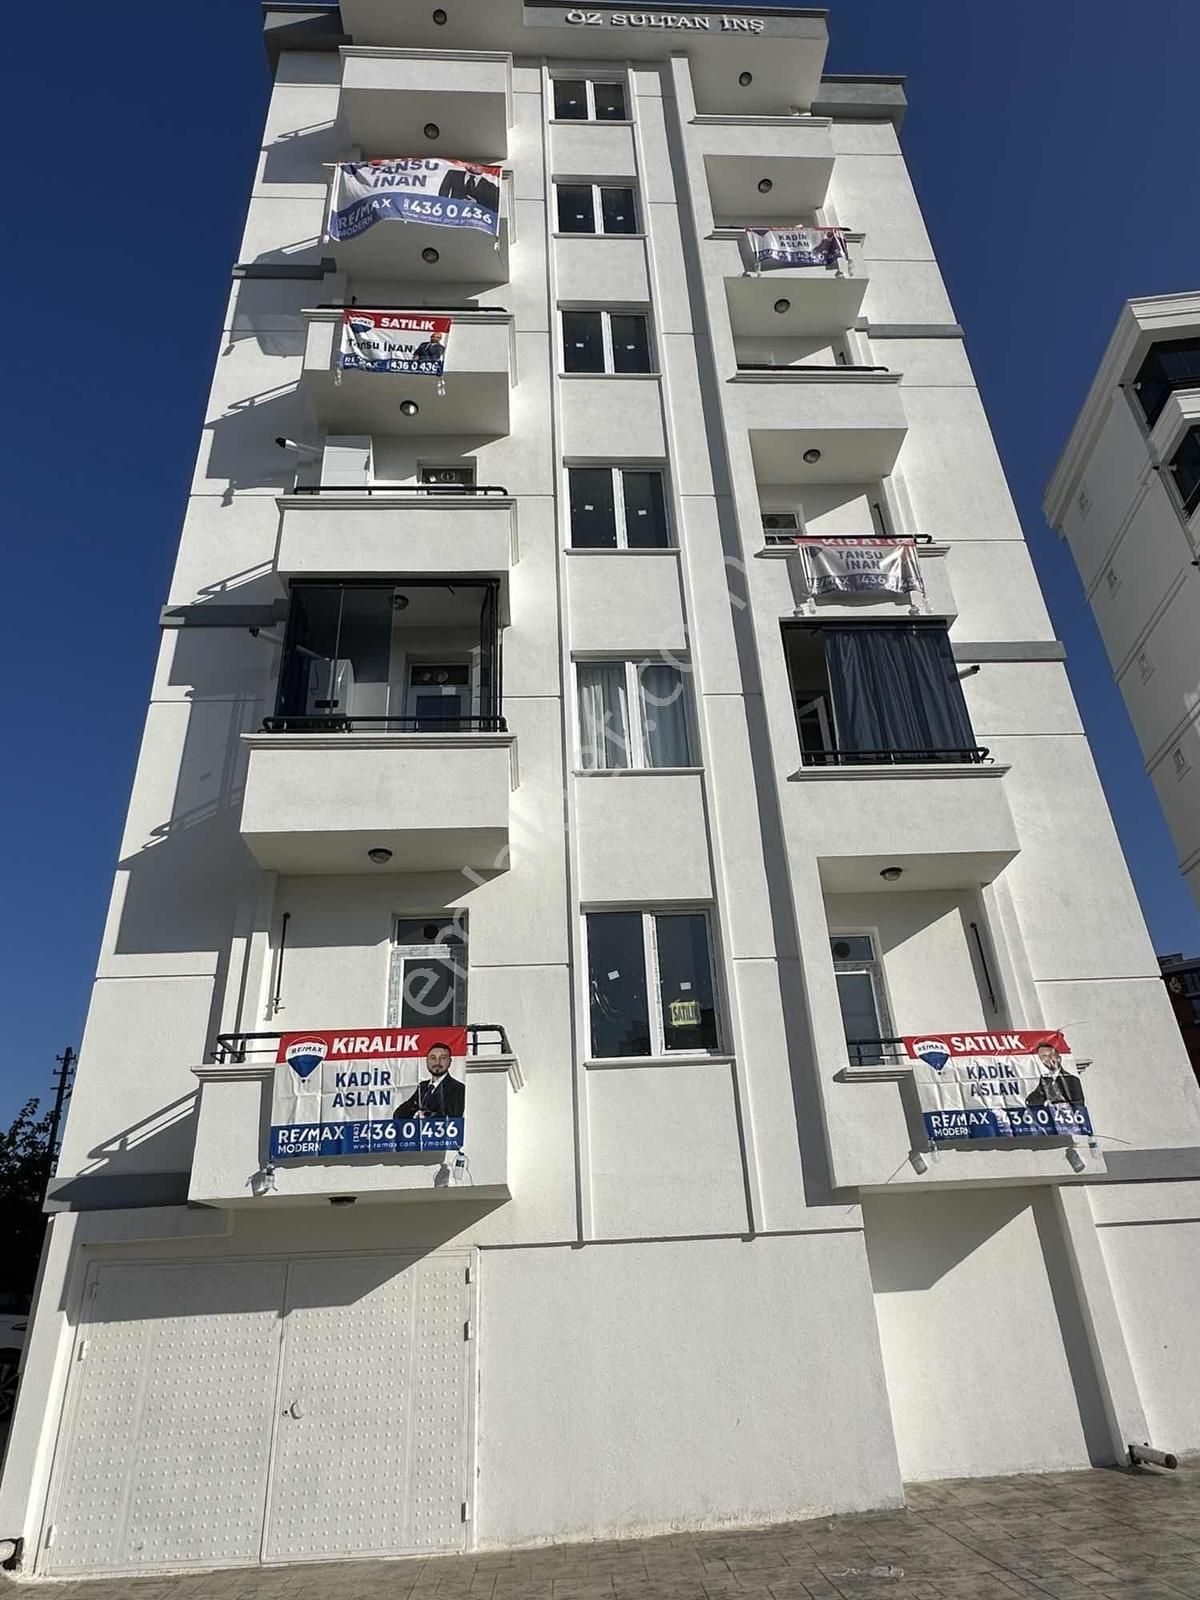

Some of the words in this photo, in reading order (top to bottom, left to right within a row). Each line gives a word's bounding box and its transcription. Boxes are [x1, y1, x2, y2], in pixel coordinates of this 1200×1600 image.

[566, 9, 603, 24] ÖZ
[611, 13, 710, 29] SULTAN
[721, 14, 765, 34] İNŞ
[337, 198, 392, 229] RE/MAX
[410, 200, 442, 215] 436
[446, 204, 458, 218] 0
[461, 207, 493, 225] 436
[380, 317, 436, 331] SATILIK
[838, 550, 884, 560] TANSU
[290, 1045, 324, 1055] RE/MAX
[951, 1034, 1026, 1052] SATILIK
[335, 1067, 391, 1088] KADİR
[966, 1062, 1016, 1080] KADİR
[970, 1081, 1020, 1097] ASLAN
[332, 1090, 391, 1108] ASLAN
[931, 1111, 990, 1128] RE/MAX
[1037, 1109, 1049, 1125] 0
[1054, 1109, 1086, 1125] 436
[278, 1125, 345, 1144] RE/MAX
[360, 1122, 397, 1140] 436
[402, 1121, 416, 1139] 0
[421, 1121, 459, 1138] 436
[933, 1126, 971, 1137] MODERN
[278, 1141, 322, 1154] MODERN
